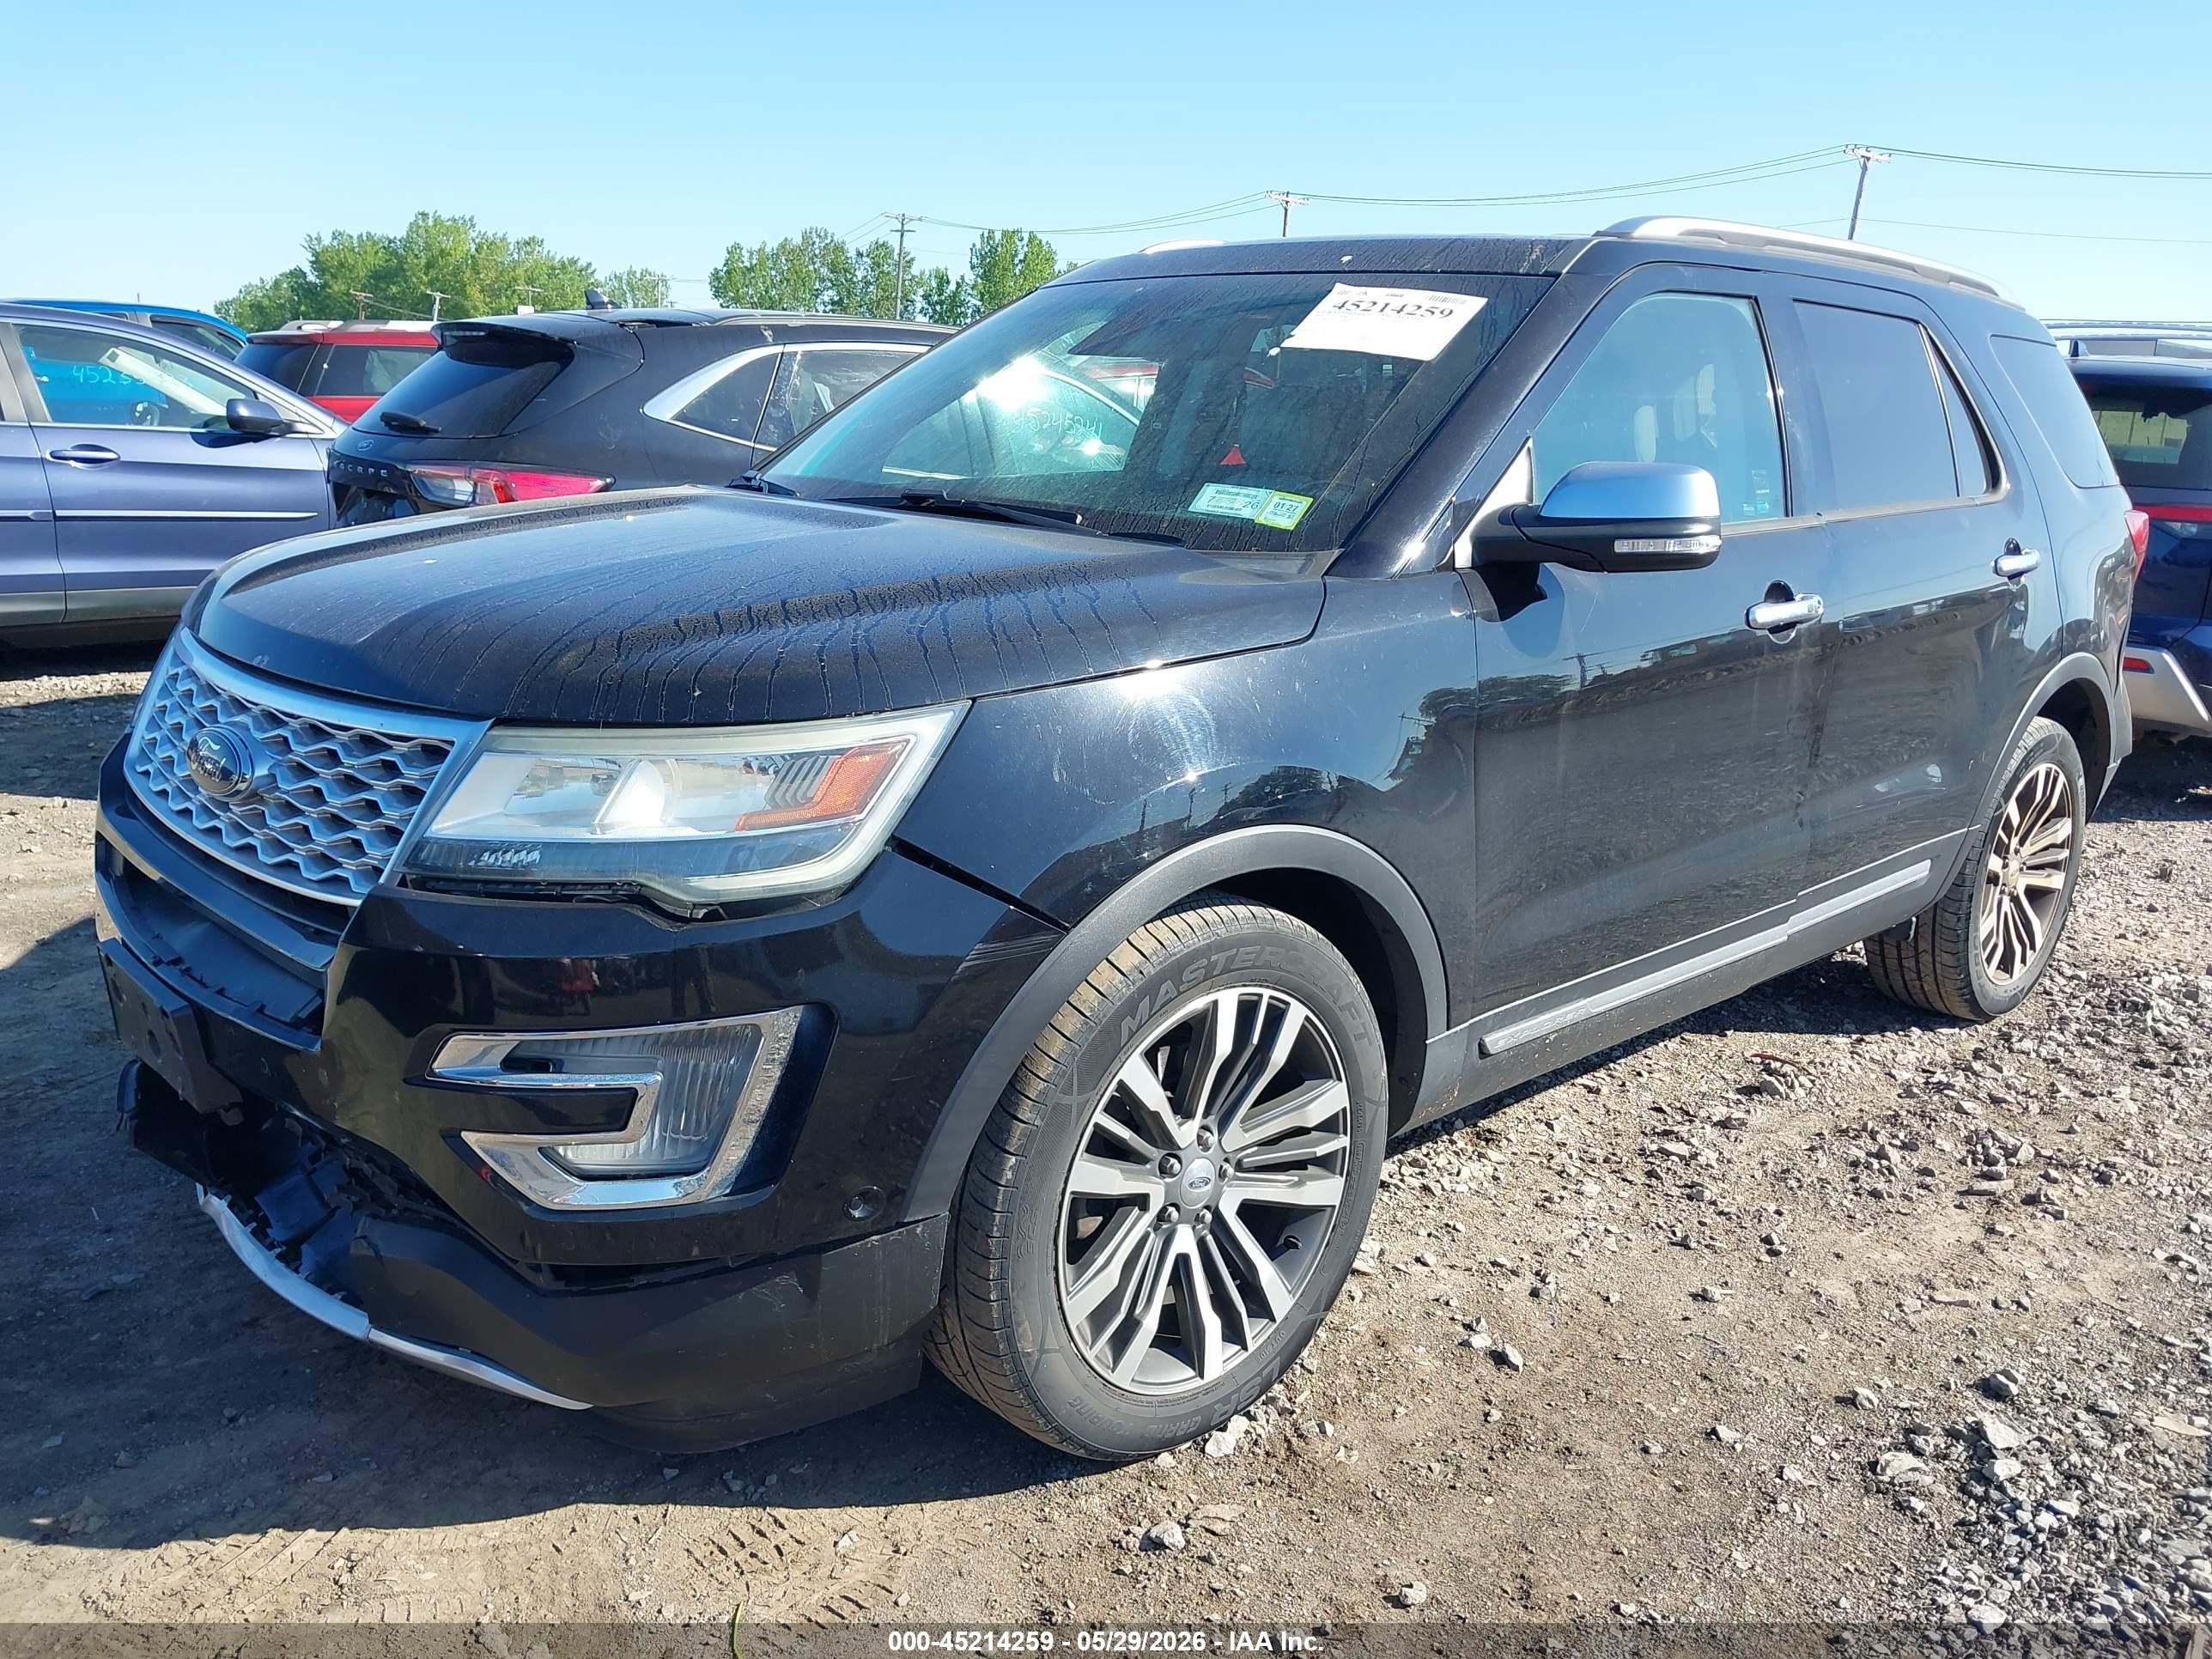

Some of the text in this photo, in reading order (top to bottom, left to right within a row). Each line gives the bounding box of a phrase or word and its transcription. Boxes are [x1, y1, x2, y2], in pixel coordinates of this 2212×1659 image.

[1332, 300, 1455, 319] 45214259
[1243, 500, 1260, 510] 26
[1119, 945, 1373, 1048] MASTERCRAFT
[1211, 1356, 1281, 1426] LSR
